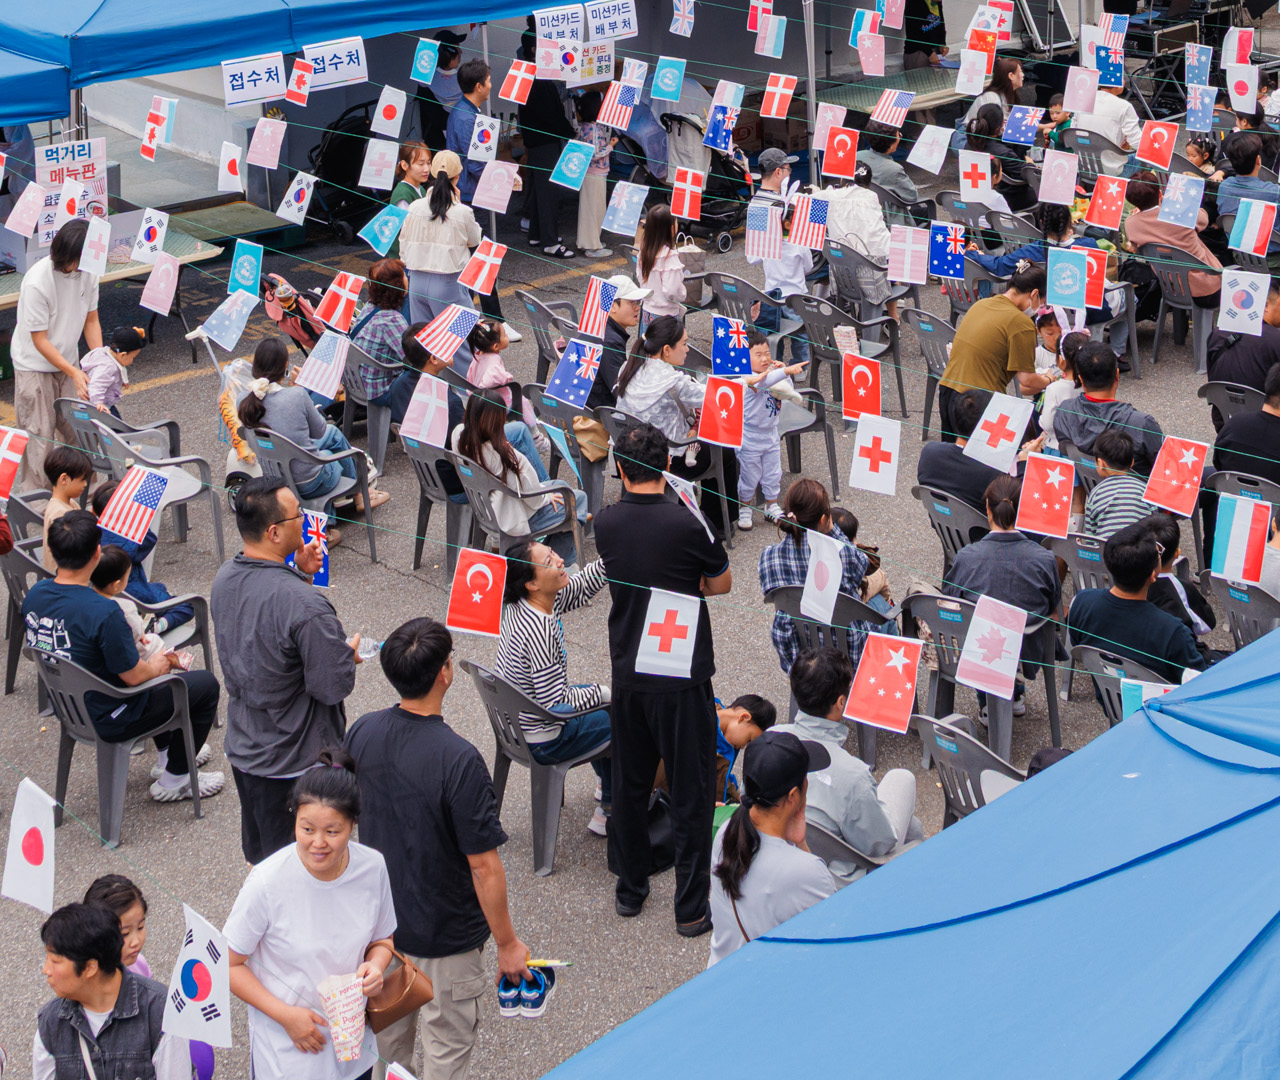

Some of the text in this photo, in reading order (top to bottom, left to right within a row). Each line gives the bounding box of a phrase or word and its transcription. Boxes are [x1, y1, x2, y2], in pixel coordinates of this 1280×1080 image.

[540, 11, 580, 29] 미션카드
[591, 2, 631, 20] 미션카드
[595, 18, 632, 35] 배부처
[592, 45, 606, 55] 카드
[311, 48, 362, 76] 접수처
[228, 65, 282, 93] 접수처
[45, 142, 91, 163] 먹거리
[50, 163, 96, 184] 메뉴판
